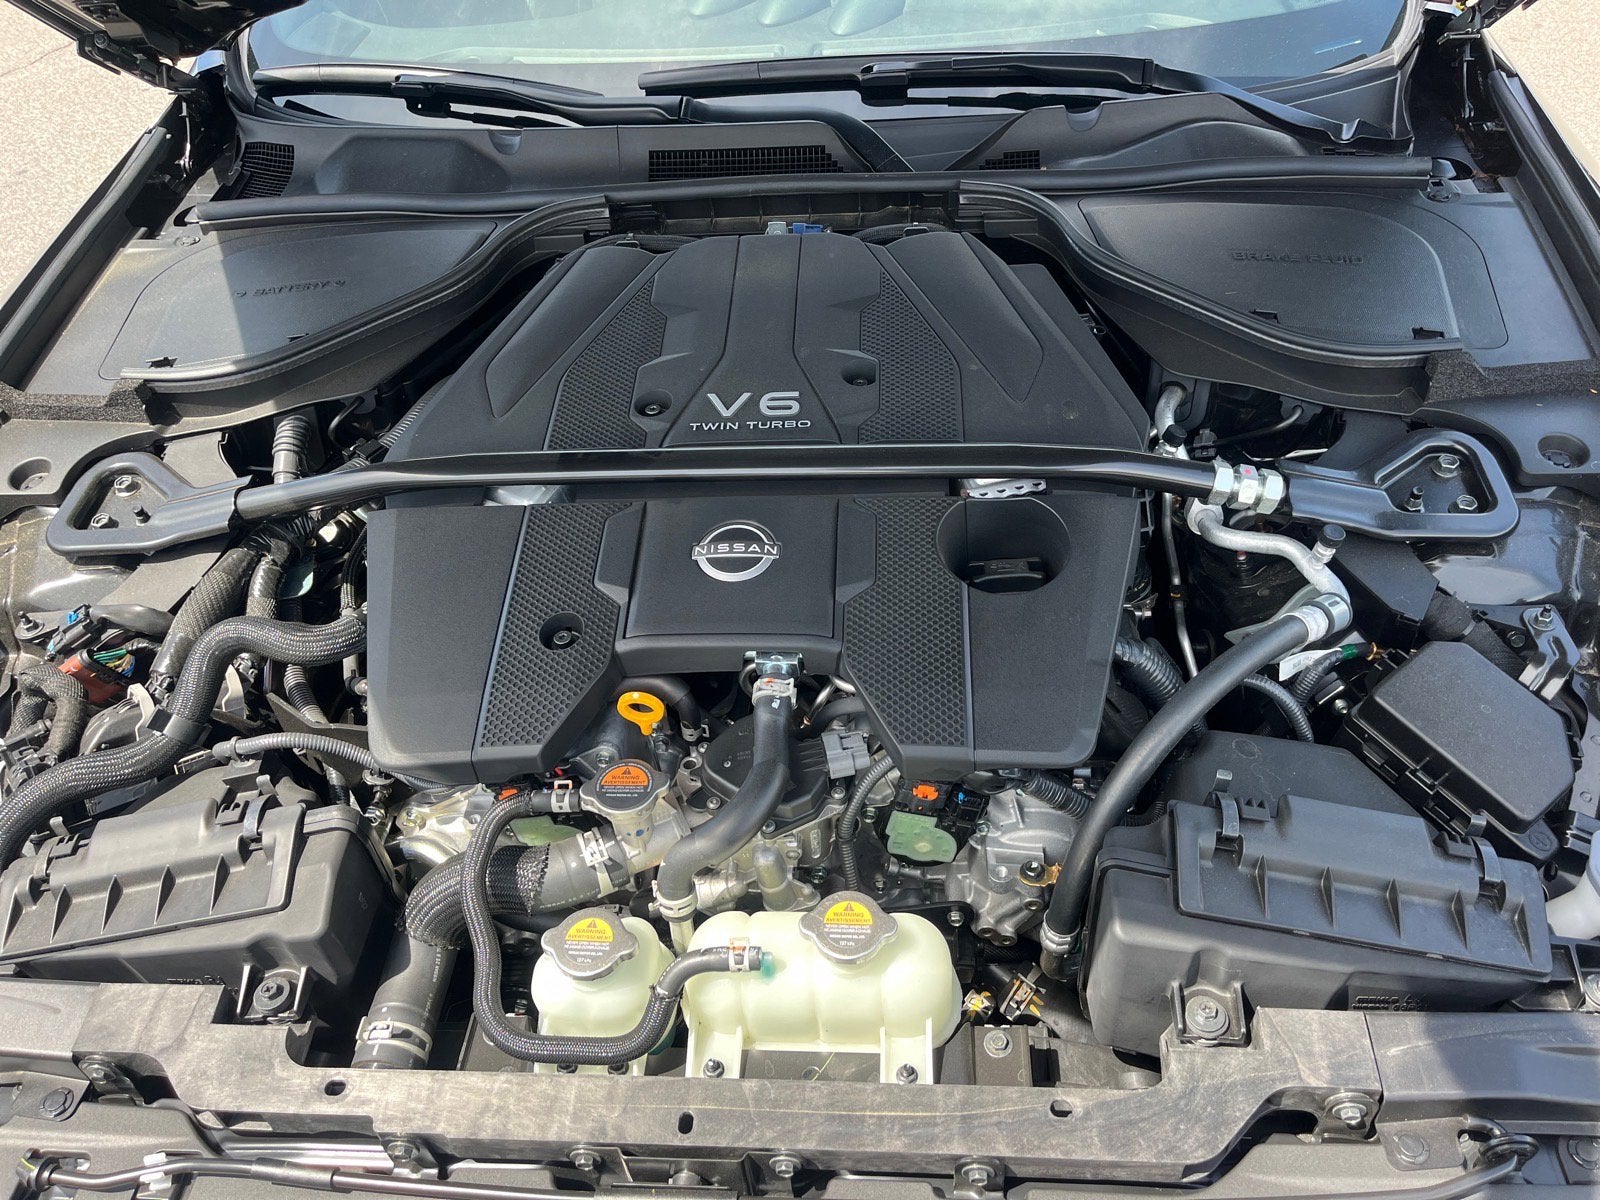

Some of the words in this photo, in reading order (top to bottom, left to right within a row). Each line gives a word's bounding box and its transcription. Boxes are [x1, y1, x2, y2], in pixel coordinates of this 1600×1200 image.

[1231, 251, 1301, 263] BRAKE
[1305, 254, 1363, 264] FLUID
[253, 280, 330, 297] BATTERY
[706, 391, 800, 417] V6
[689, 421, 739, 431] TWIN
[746, 420, 811, 430] TURBO
[693, 543, 778, 556] NISSAN
